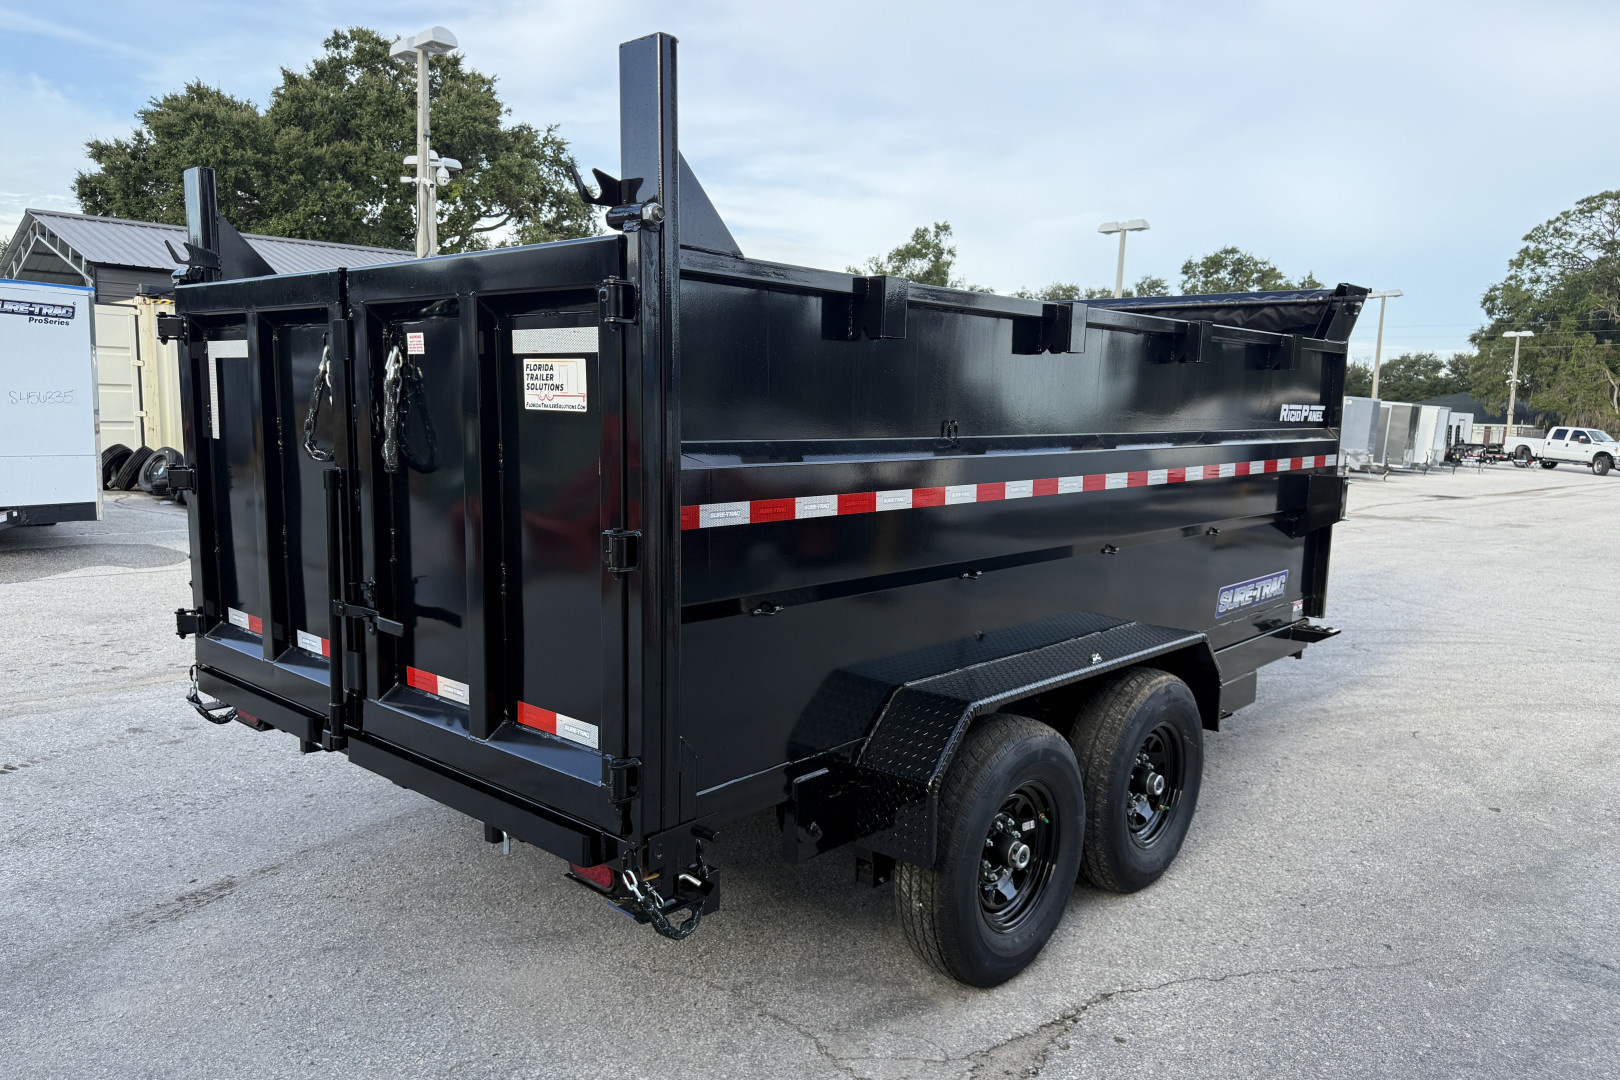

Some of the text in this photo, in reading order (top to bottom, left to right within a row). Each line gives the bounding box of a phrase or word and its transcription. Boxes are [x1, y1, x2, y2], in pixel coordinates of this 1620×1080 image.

[0, 301, 73, 317] URE-TRAC
[29, 317, 70, 326] ProSeries
[525, 363, 554, 371] FLORIDA
[526, 373, 555, 381] TRAILER
[526, 383, 565, 391] SOLUTIONS
[709, 510, 741, 519] SURE-TRAC
[1218, 575, 1286, 613] SURE-TRAC
[564, 724, 590, 738] SURE-TRAC
